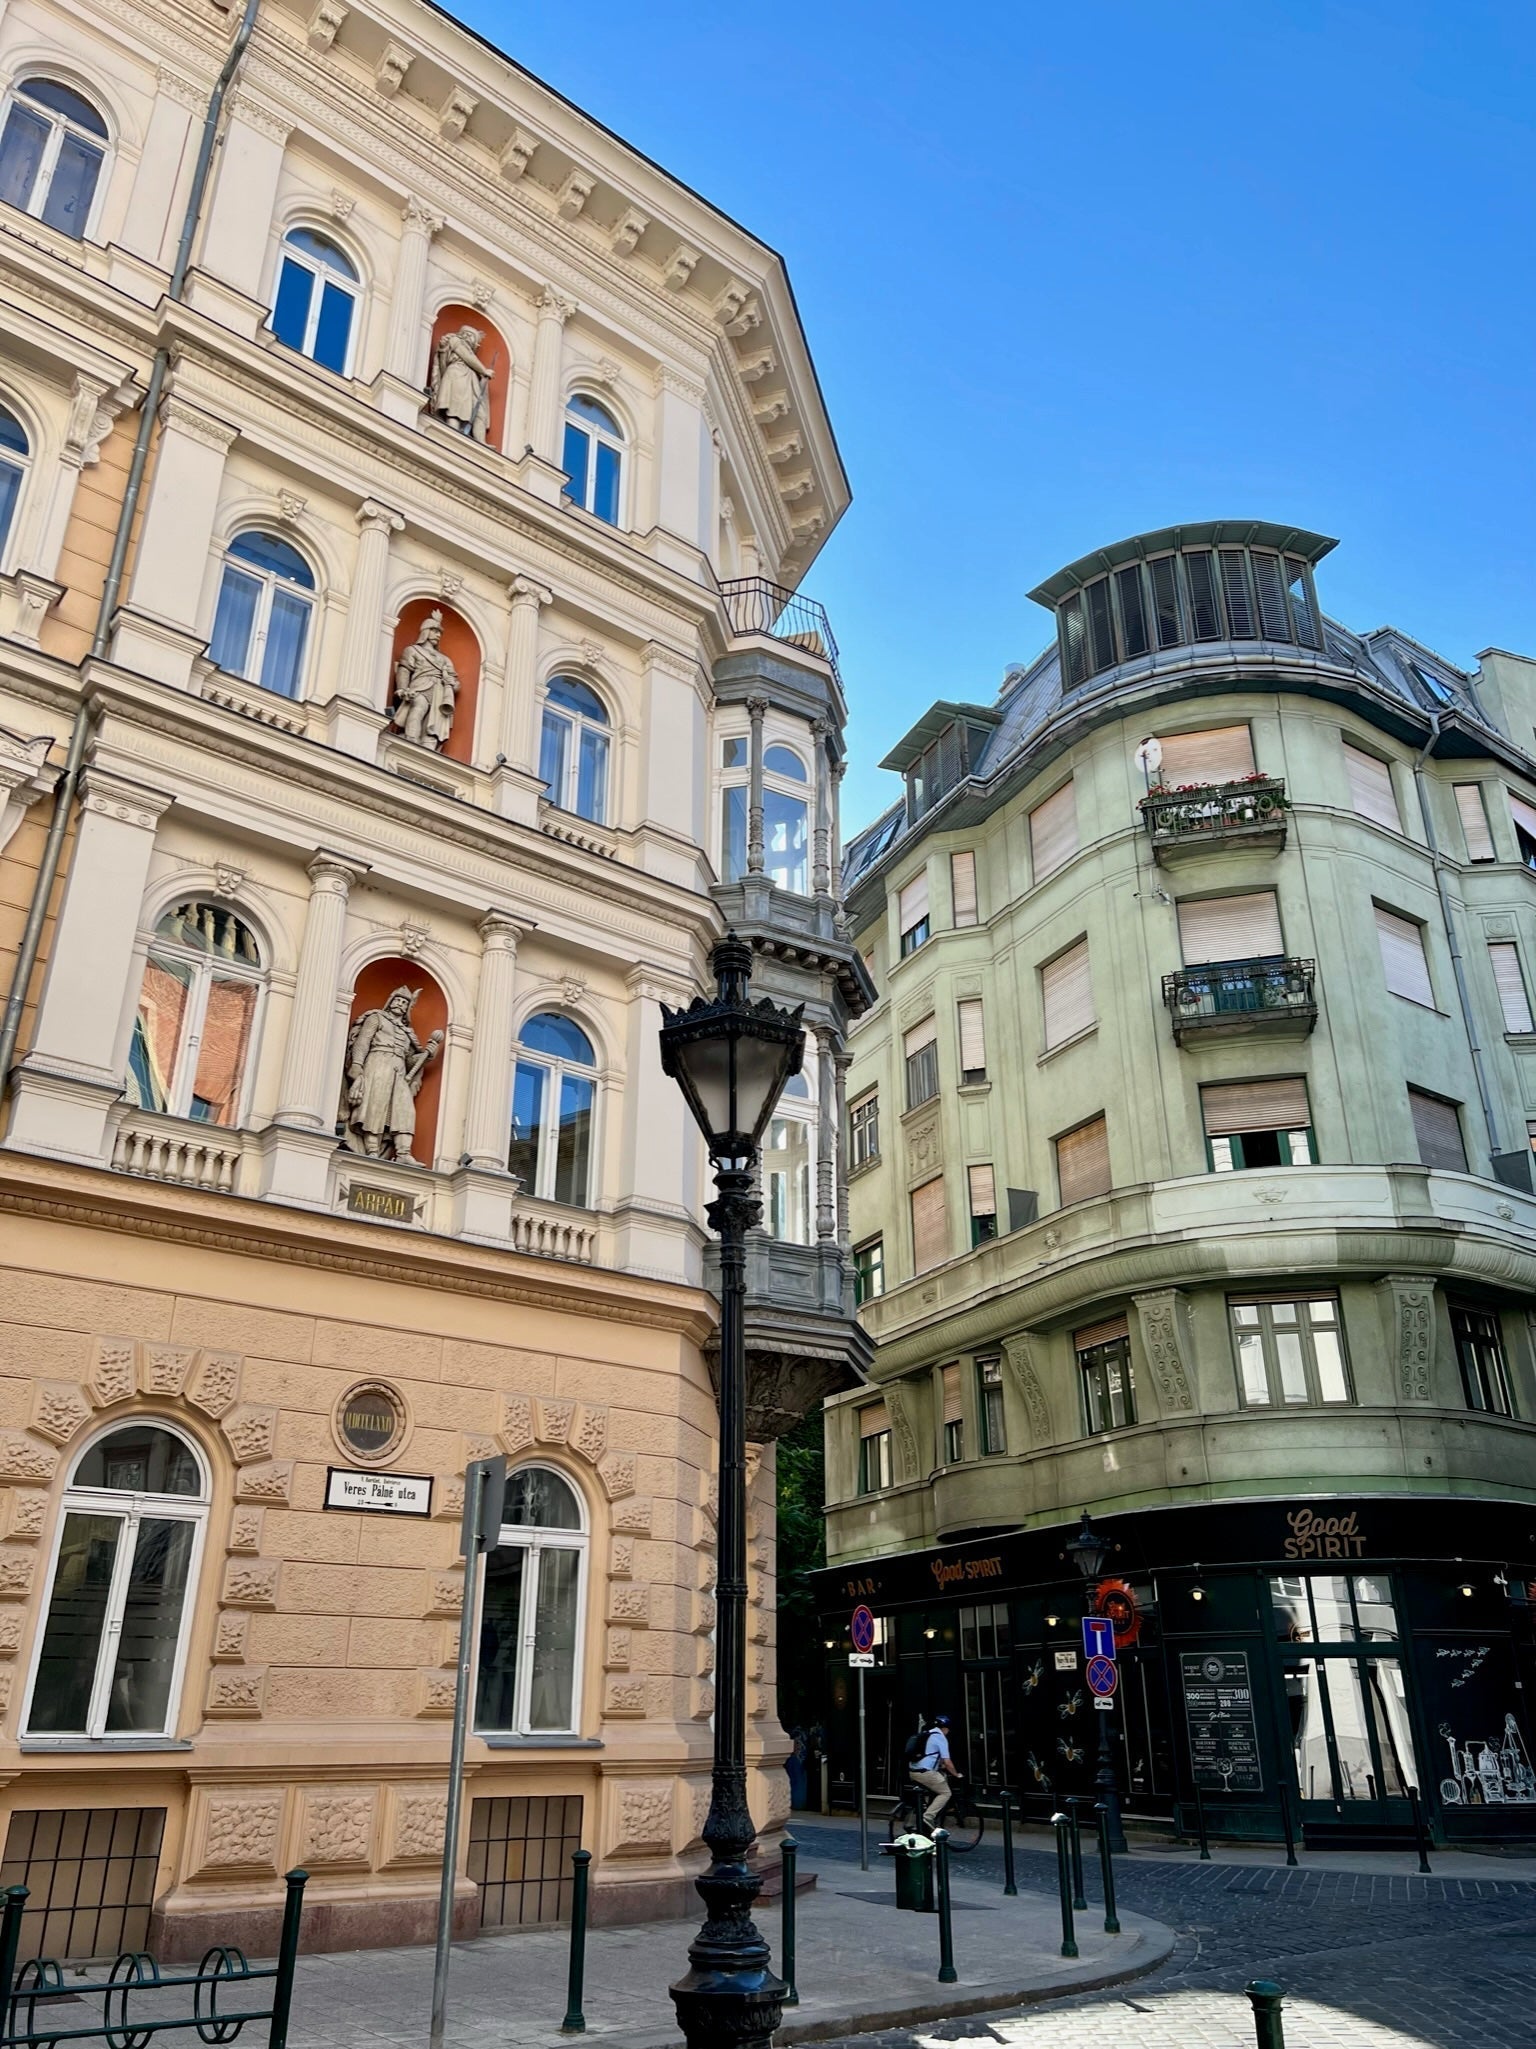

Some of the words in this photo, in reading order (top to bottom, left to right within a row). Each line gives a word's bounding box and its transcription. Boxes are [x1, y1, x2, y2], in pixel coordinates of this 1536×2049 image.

[354, 1188, 405, 1216] ÁRPÁD
[344, 1481, 367, 1496] Veres
[371, 1484, 394, 1498] Pálné
[398, 1487, 416, 1500] utca
[1287, 1508, 1359, 1545] Good
[1283, 1536, 1367, 1558] SPIRIT
[931, 1558, 965, 1590] Good
[964, 1556, 1002, 1579] SPIRIT
[847, 1578, 876, 1597] BAR
